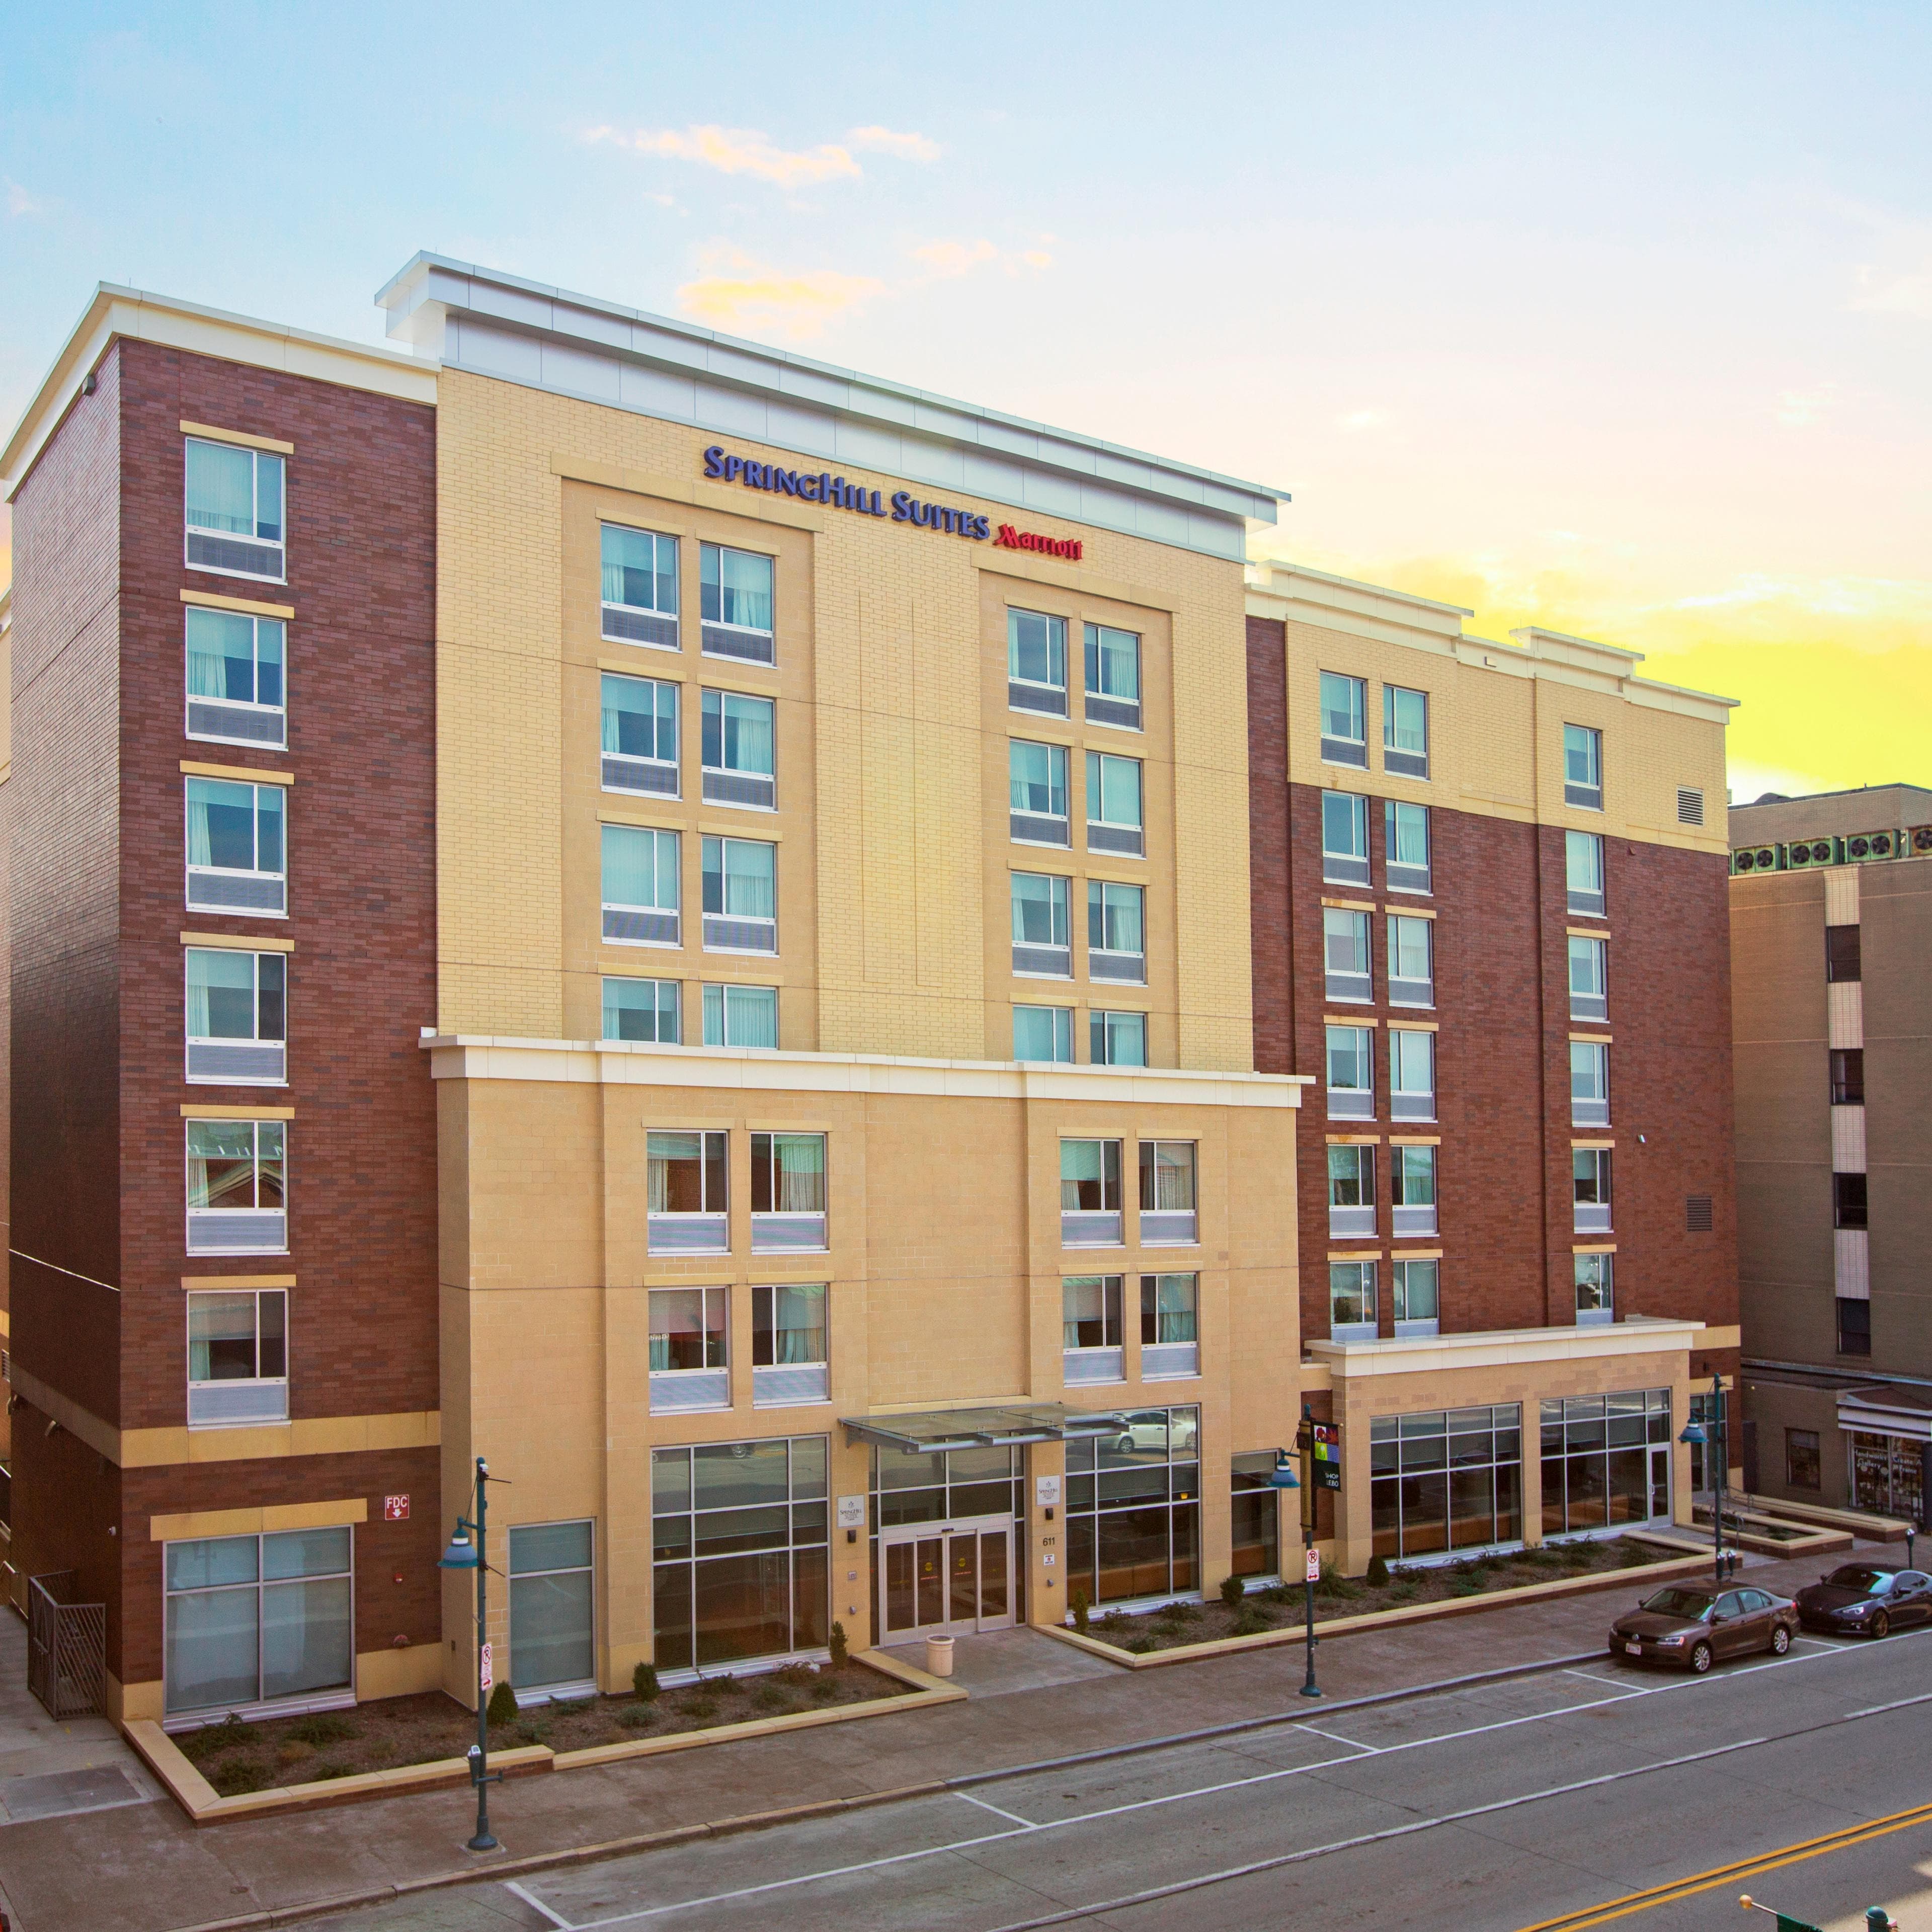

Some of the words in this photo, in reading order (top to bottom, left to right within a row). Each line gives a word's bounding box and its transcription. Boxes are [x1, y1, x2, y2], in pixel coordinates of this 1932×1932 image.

[892, 491, 990, 540] SUITES
[993, 523, 1083, 560] Marriott
[387, 1496, 407, 1509] FDC
[1042, 1537, 1055, 1546] 611
